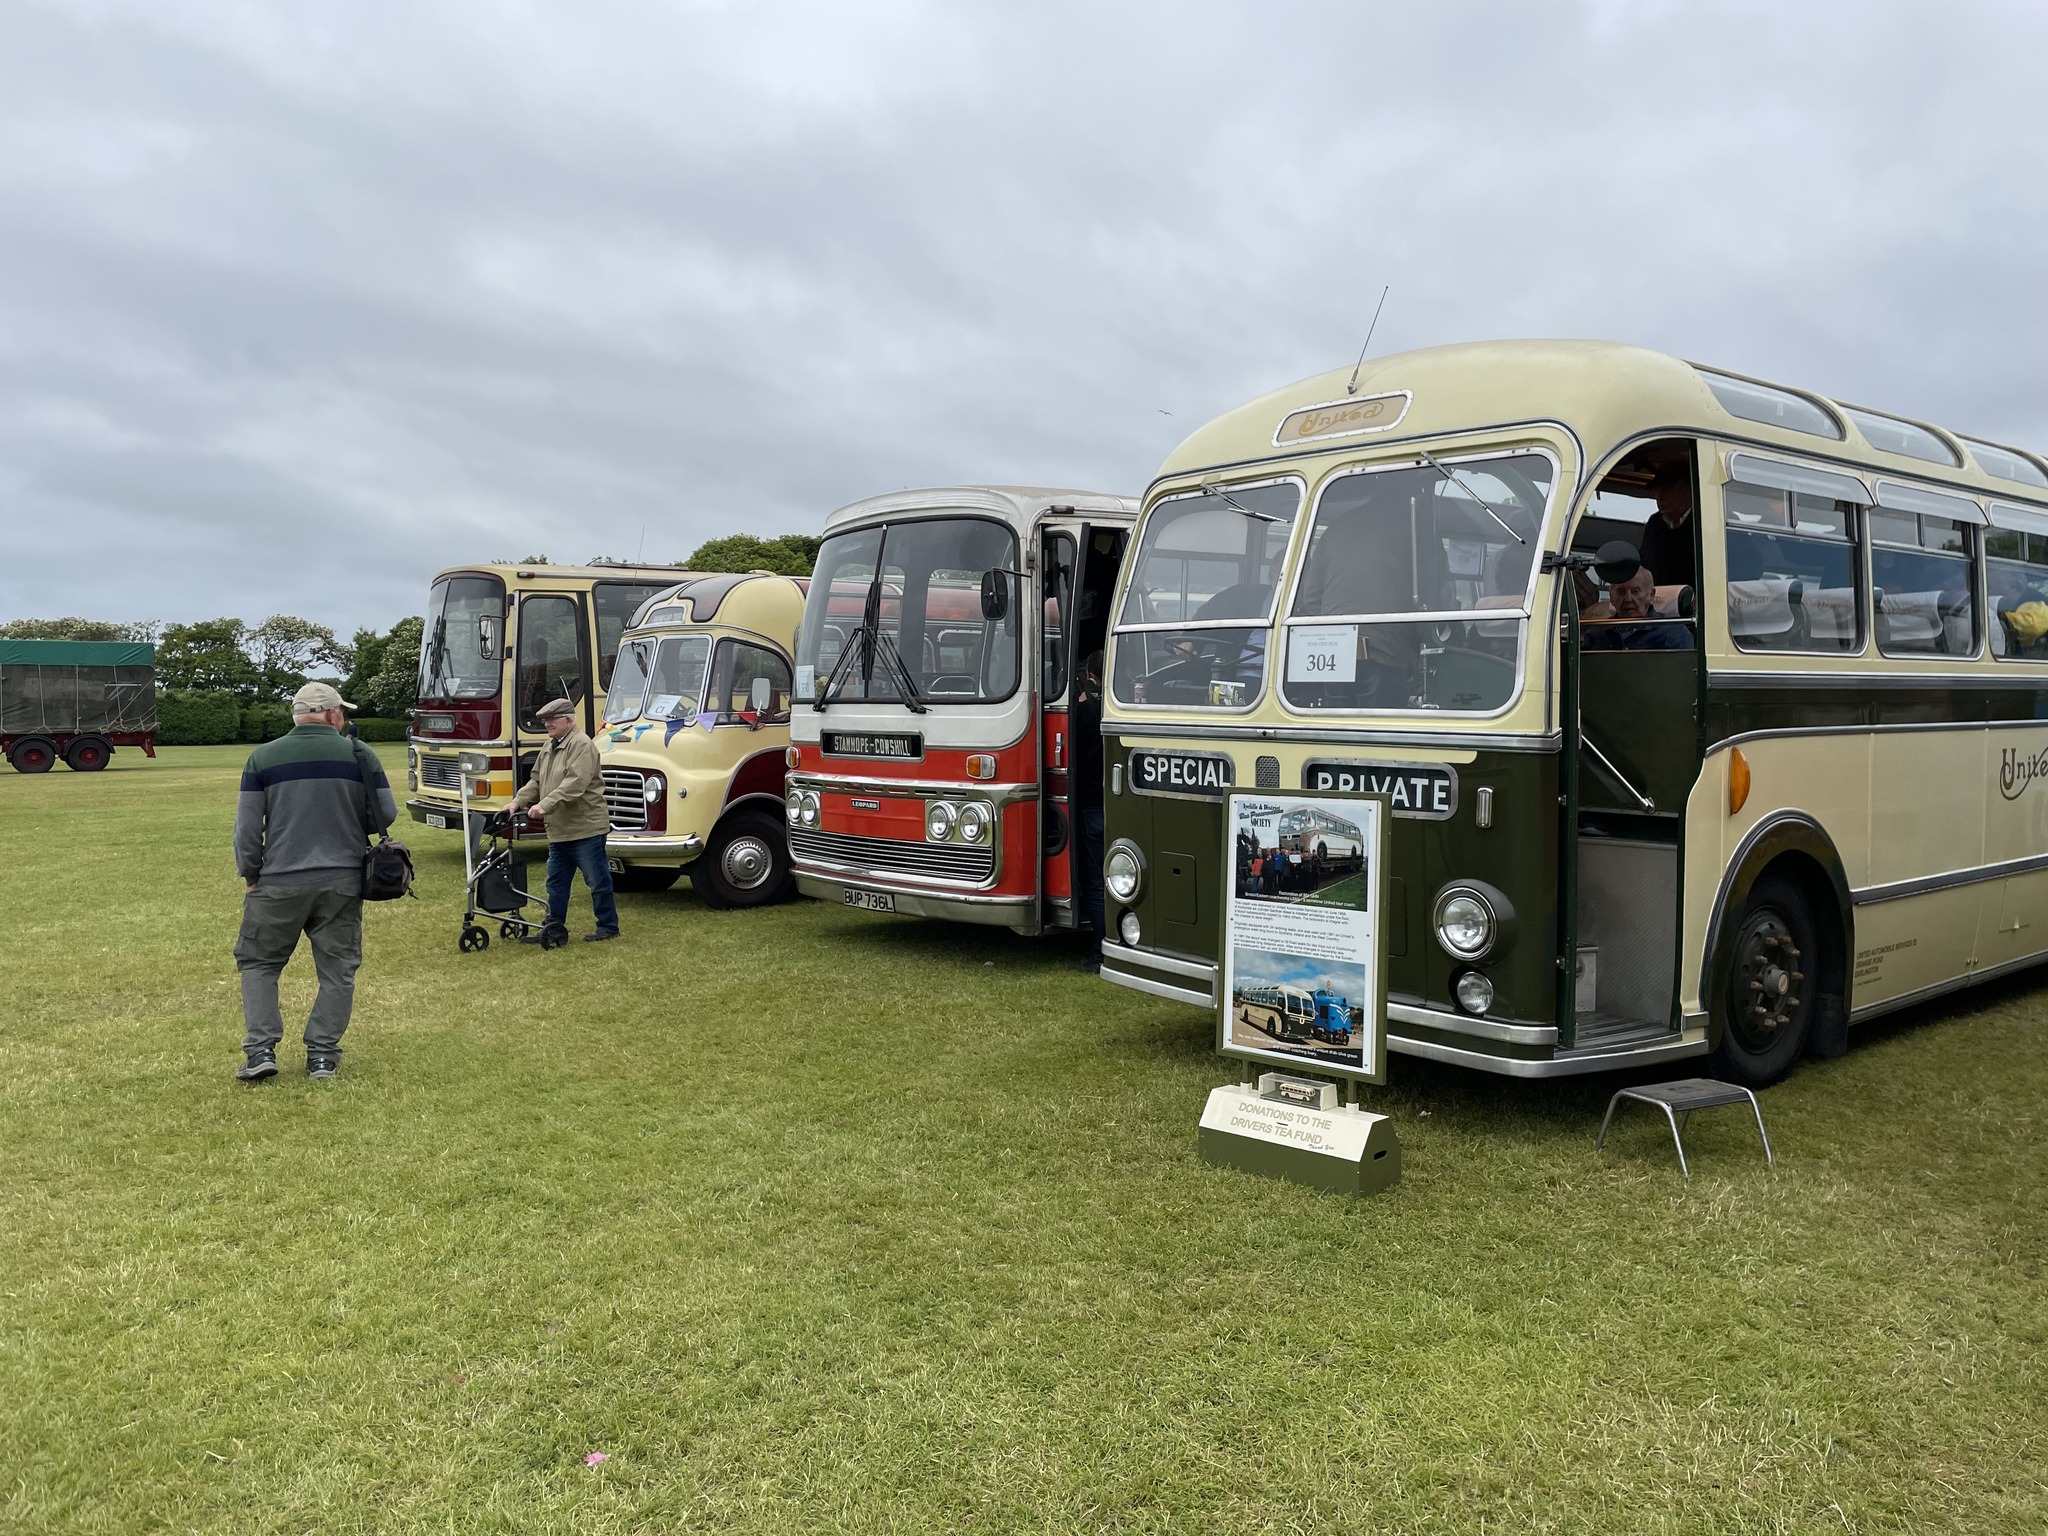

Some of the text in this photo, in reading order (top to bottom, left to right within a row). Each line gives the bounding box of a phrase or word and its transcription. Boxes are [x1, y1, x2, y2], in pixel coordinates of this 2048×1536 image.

[1299, 402, 1384, 436] United
[1307, 654, 1336, 671] 304
[1143, 756, 1231, 788] SPECIAL
[2000, 747, 2048, 800] Unite
[852, 801, 878, 809] LEOPARD
[1317, 772, 1450, 811] PRIVATE
[1251, 818, 1270, 827] SOCIETY
[845, 891, 892, 910] BUP 736L
[1230, 1116, 1322, 1144] DRIVERS TEA FUND
[1238, 1102, 1332, 1130] DONATIONS TO THE
